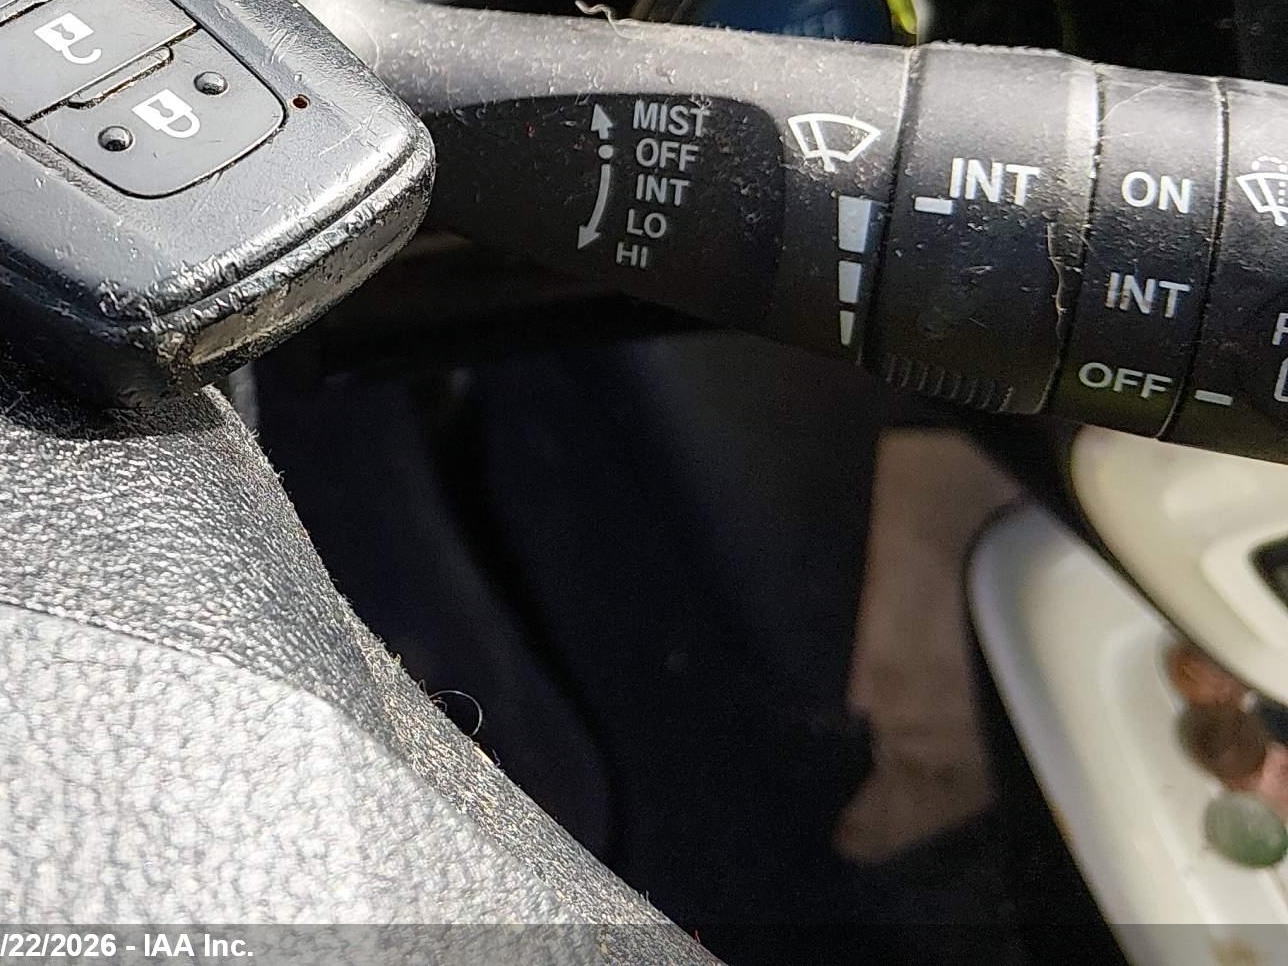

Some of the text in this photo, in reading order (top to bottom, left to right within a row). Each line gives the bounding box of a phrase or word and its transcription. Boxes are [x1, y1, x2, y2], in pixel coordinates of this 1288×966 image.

[632, 100, 711, 137] MIST
[635, 137, 700, 172] OFF
[635, 174, 691, 207] INT
[948, 157, 1042, 207] INT
[1121, 171, 1193, 214] ON
[626, 208, 668, 238] LO
[615, 241, 649, 269] HI
[1104, 272, 1192, 319] INT
[1078, 361, 1174, 400] OFF
